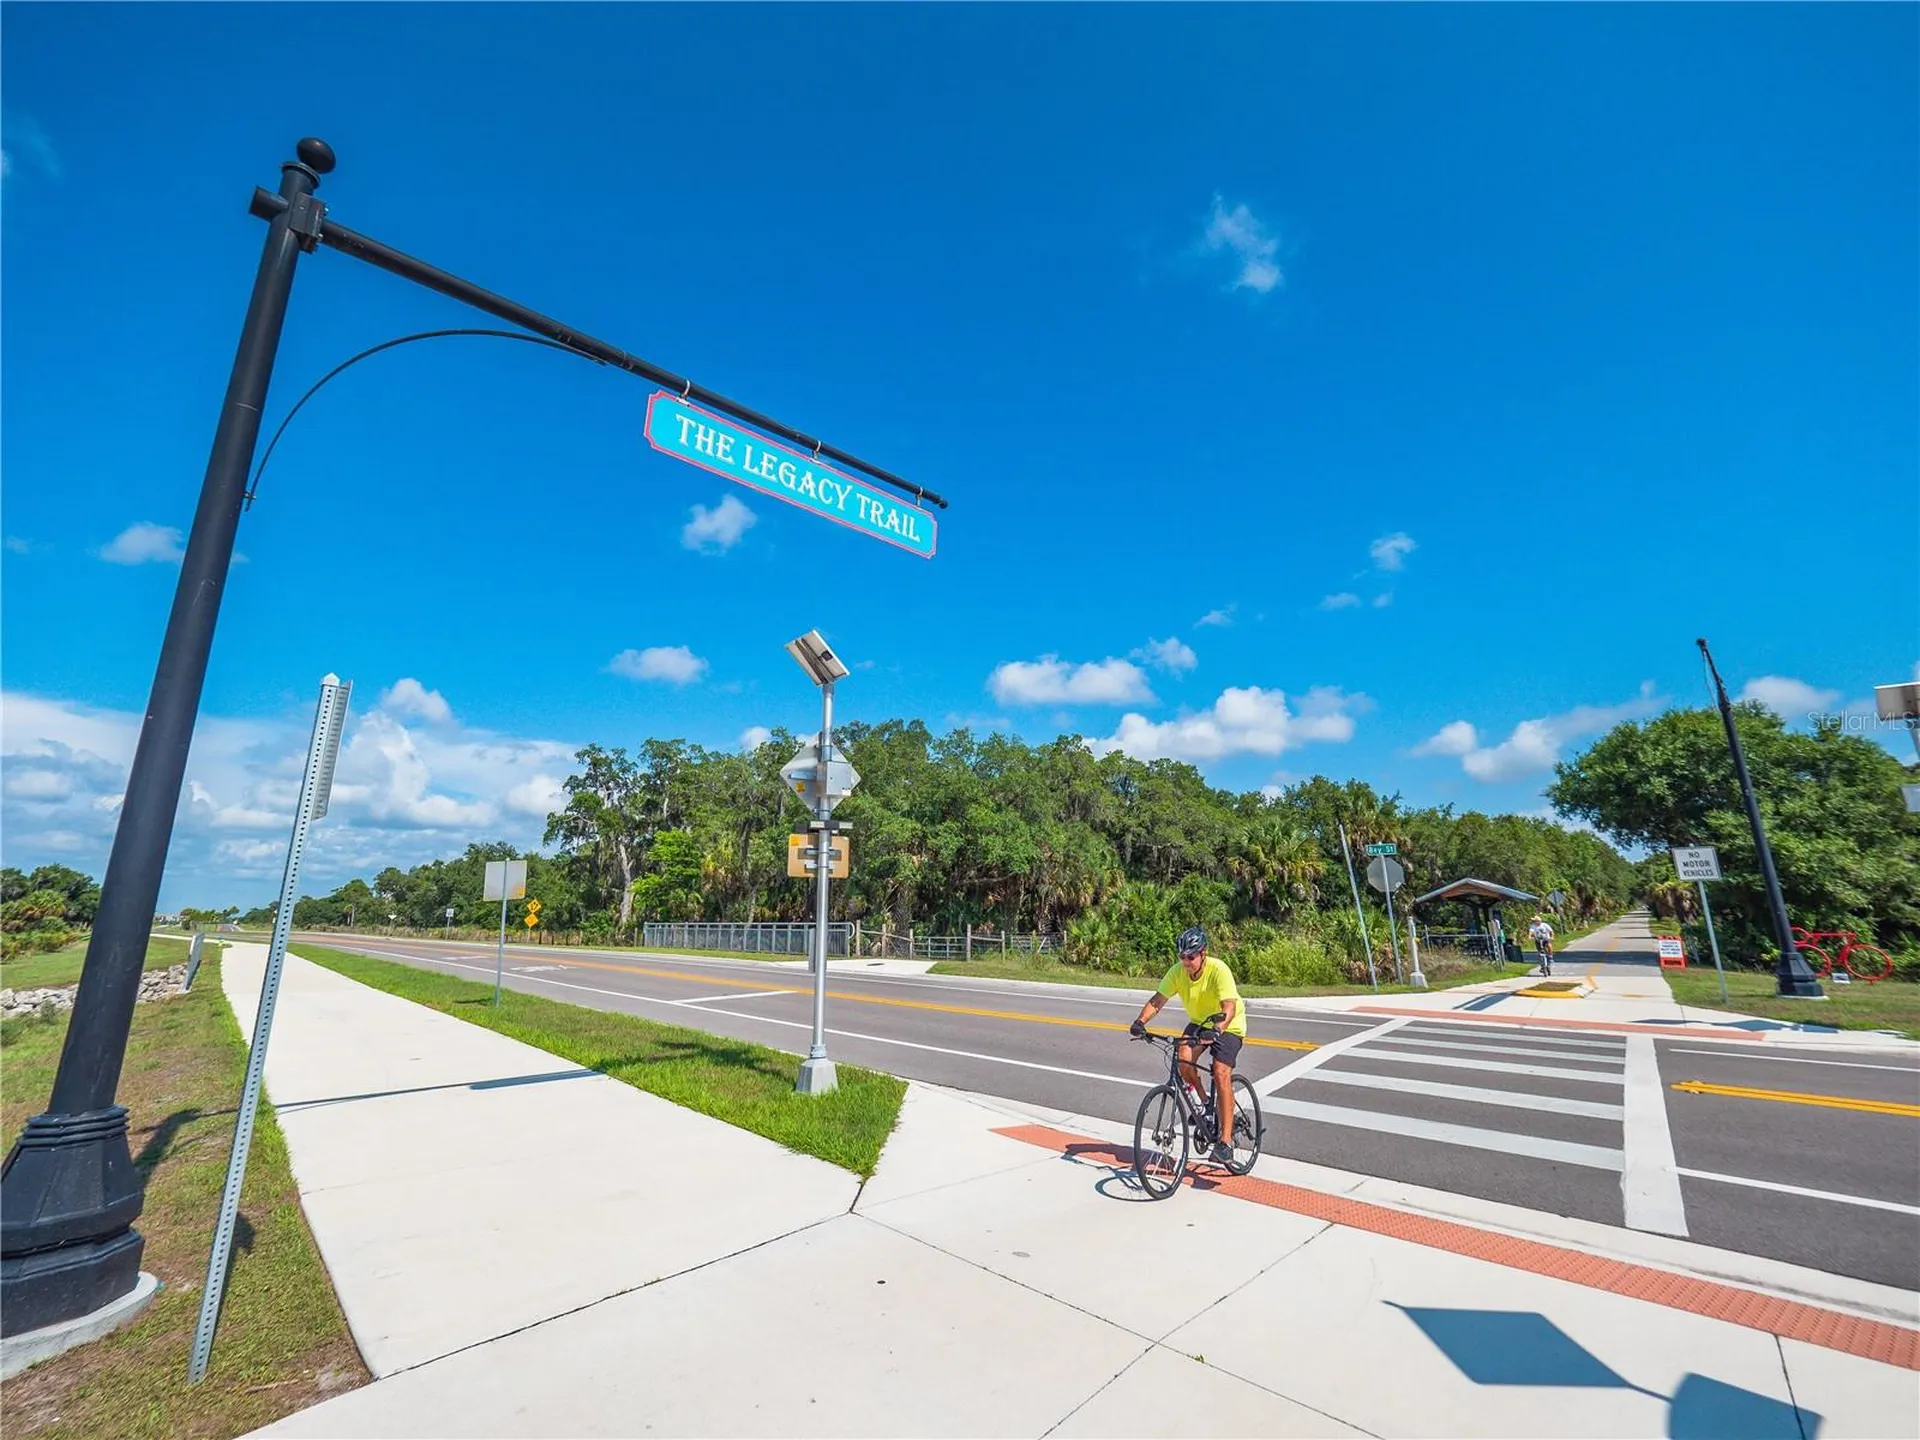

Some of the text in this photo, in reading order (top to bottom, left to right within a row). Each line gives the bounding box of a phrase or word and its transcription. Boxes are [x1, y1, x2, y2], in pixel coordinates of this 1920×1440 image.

[675, 413, 921, 542] THE LEGACY TRAIL
[1385, 845, 1394, 853] St
[1682, 860, 1711, 868] MOTOR
